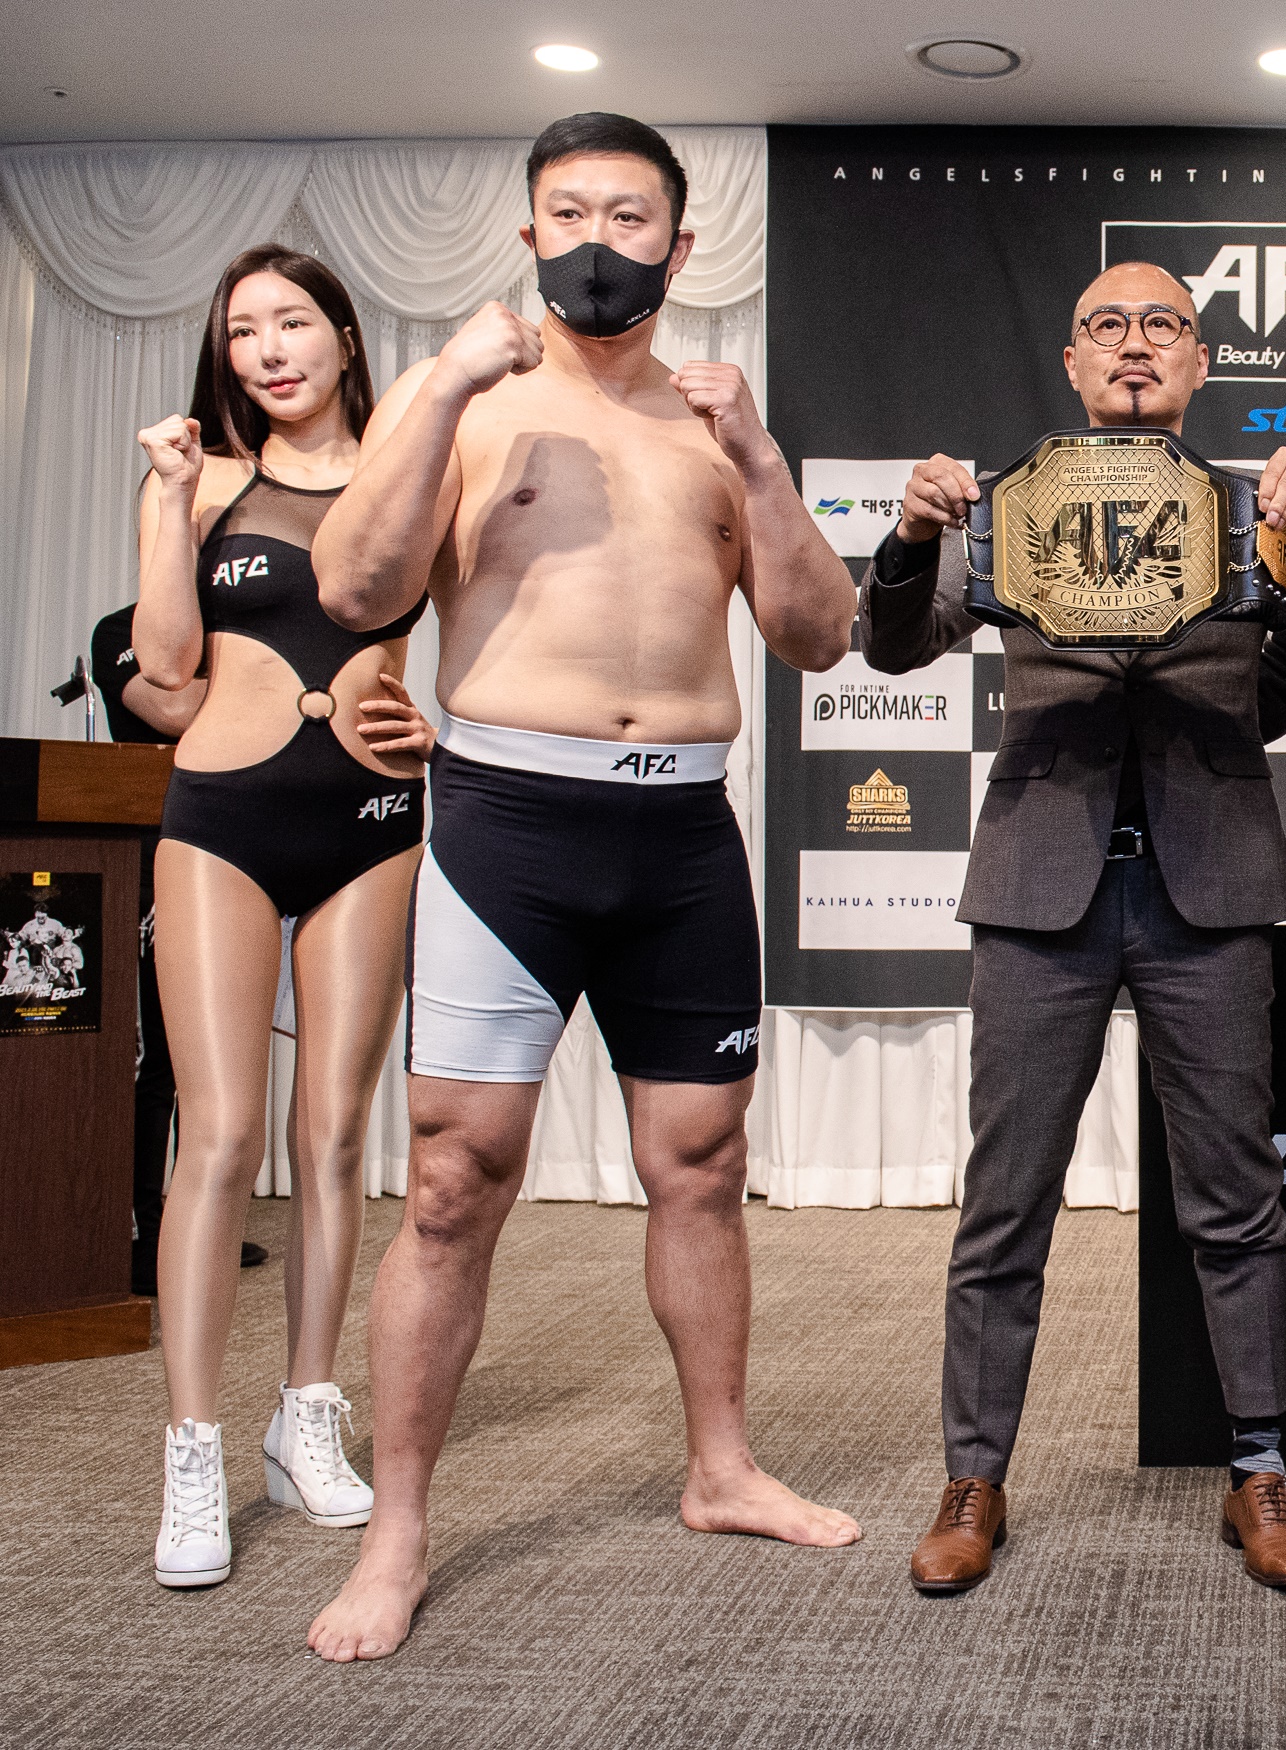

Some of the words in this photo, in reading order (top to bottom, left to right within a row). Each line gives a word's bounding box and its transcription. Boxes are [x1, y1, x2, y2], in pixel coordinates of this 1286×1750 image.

[1217, 345, 1284, 369] Beauty
[1063, 465, 1105, 474] ANGEL'S
[1107, 465, 1156, 474] FIGHTING
[1070, 474, 1148, 483] CHAMPIONSHIP
[213, 555, 268, 587] AFC
[1060, 588, 1160, 607] CHAMPION
[840, 684, 855, 693] FOR
[860, 684, 890, 694] INTIME
[840, 694, 947, 720] PICKMAKER
[610, 752, 677, 779] AFC
[852, 787, 905, 802] SHARKS
[357, 792, 410, 821] AFC
[846, 814, 911, 824] JUTTKOREA
[806, 896, 874, 907] KAIHUA
[887, 897, 956, 907] STUDIO
